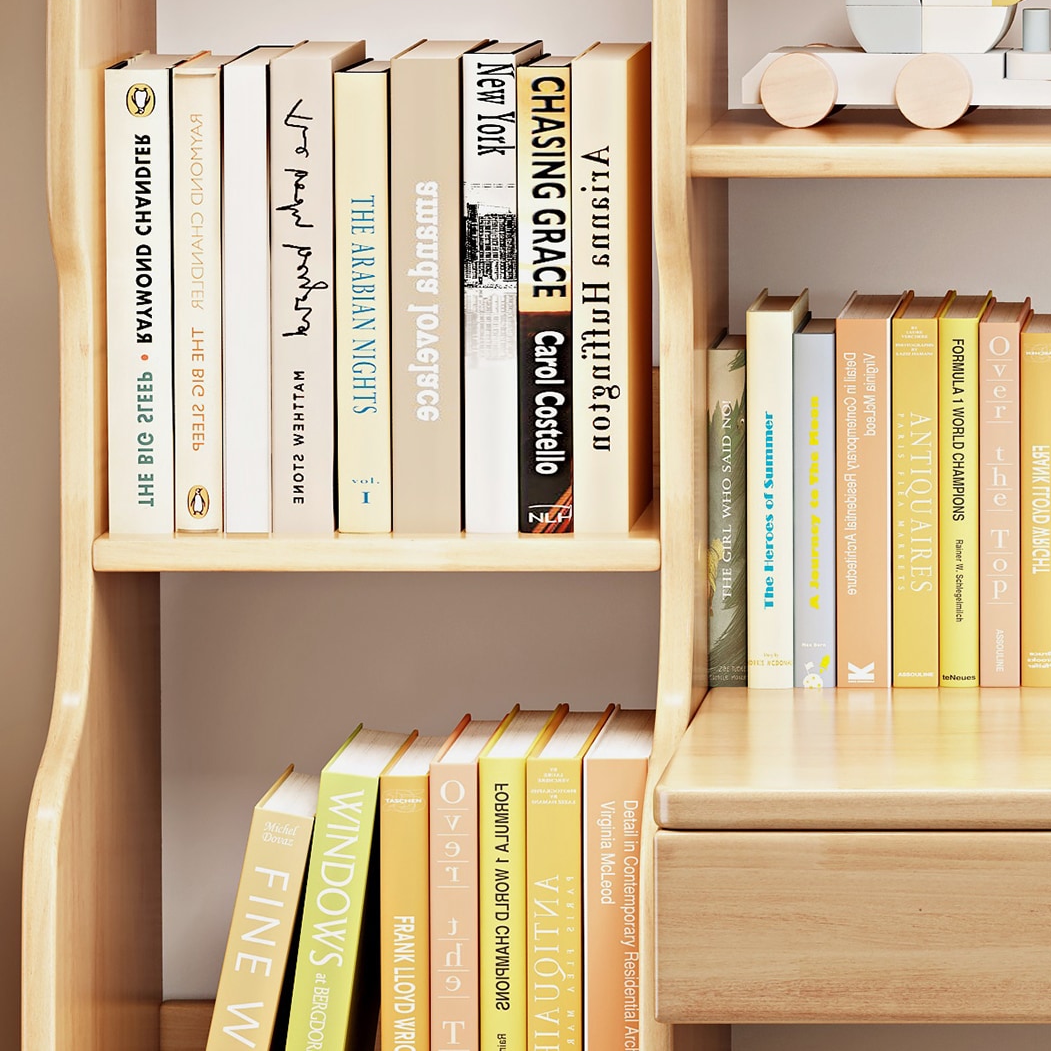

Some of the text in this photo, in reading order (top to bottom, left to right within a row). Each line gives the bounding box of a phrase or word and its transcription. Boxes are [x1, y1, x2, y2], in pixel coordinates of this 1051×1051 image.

[475, 62, 517, 157] New York
[530, 75, 568, 299] CHASING GRACE
[350, 194, 378, 416] THE ARABIAN NIGHTS
[533, 330, 567, 476] Carol Costello
[951, 338, 965, 395] FORMULA
[951, 406, 965, 450] WORLD
[721, 400, 733, 602] THE GIRL WHO SAID NO!
[763, 410, 775, 610] The Heroes of Summer
[808, 395, 821, 610] A Journey to The Moon
[896, 413, 905, 591] PARIS FLEA MARKETS
[905, 412, 933, 593] ANTIQUAIRES
[951, 452, 965, 522] CHAMPIONS
[953, 539, 964, 623] Rainer W. Schlegelmilch
[942, 673, 976, 681] teNeues
[995, 628, 1005, 673] ASSOULINE
[262, 832, 295, 848] Dovaz
[263, 821, 301, 838] Michel
[385, 797, 423, 805] TASCHEN
[623, 800, 640, 838] Detail
[308, 788, 366, 969] WINDOWS
[596, 800, 616, 905] Virginia McLeod
[624, 841, 638, 852] in
[234, 865, 290, 978] FINE
[393, 915, 415, 963] FRANK
[619, 855, 640, 948] Contemporary
[314, 972, 327, 985] at
[393, 966, 416, 1015] LLOYD
[623, 950, 640, 1023] Residential
